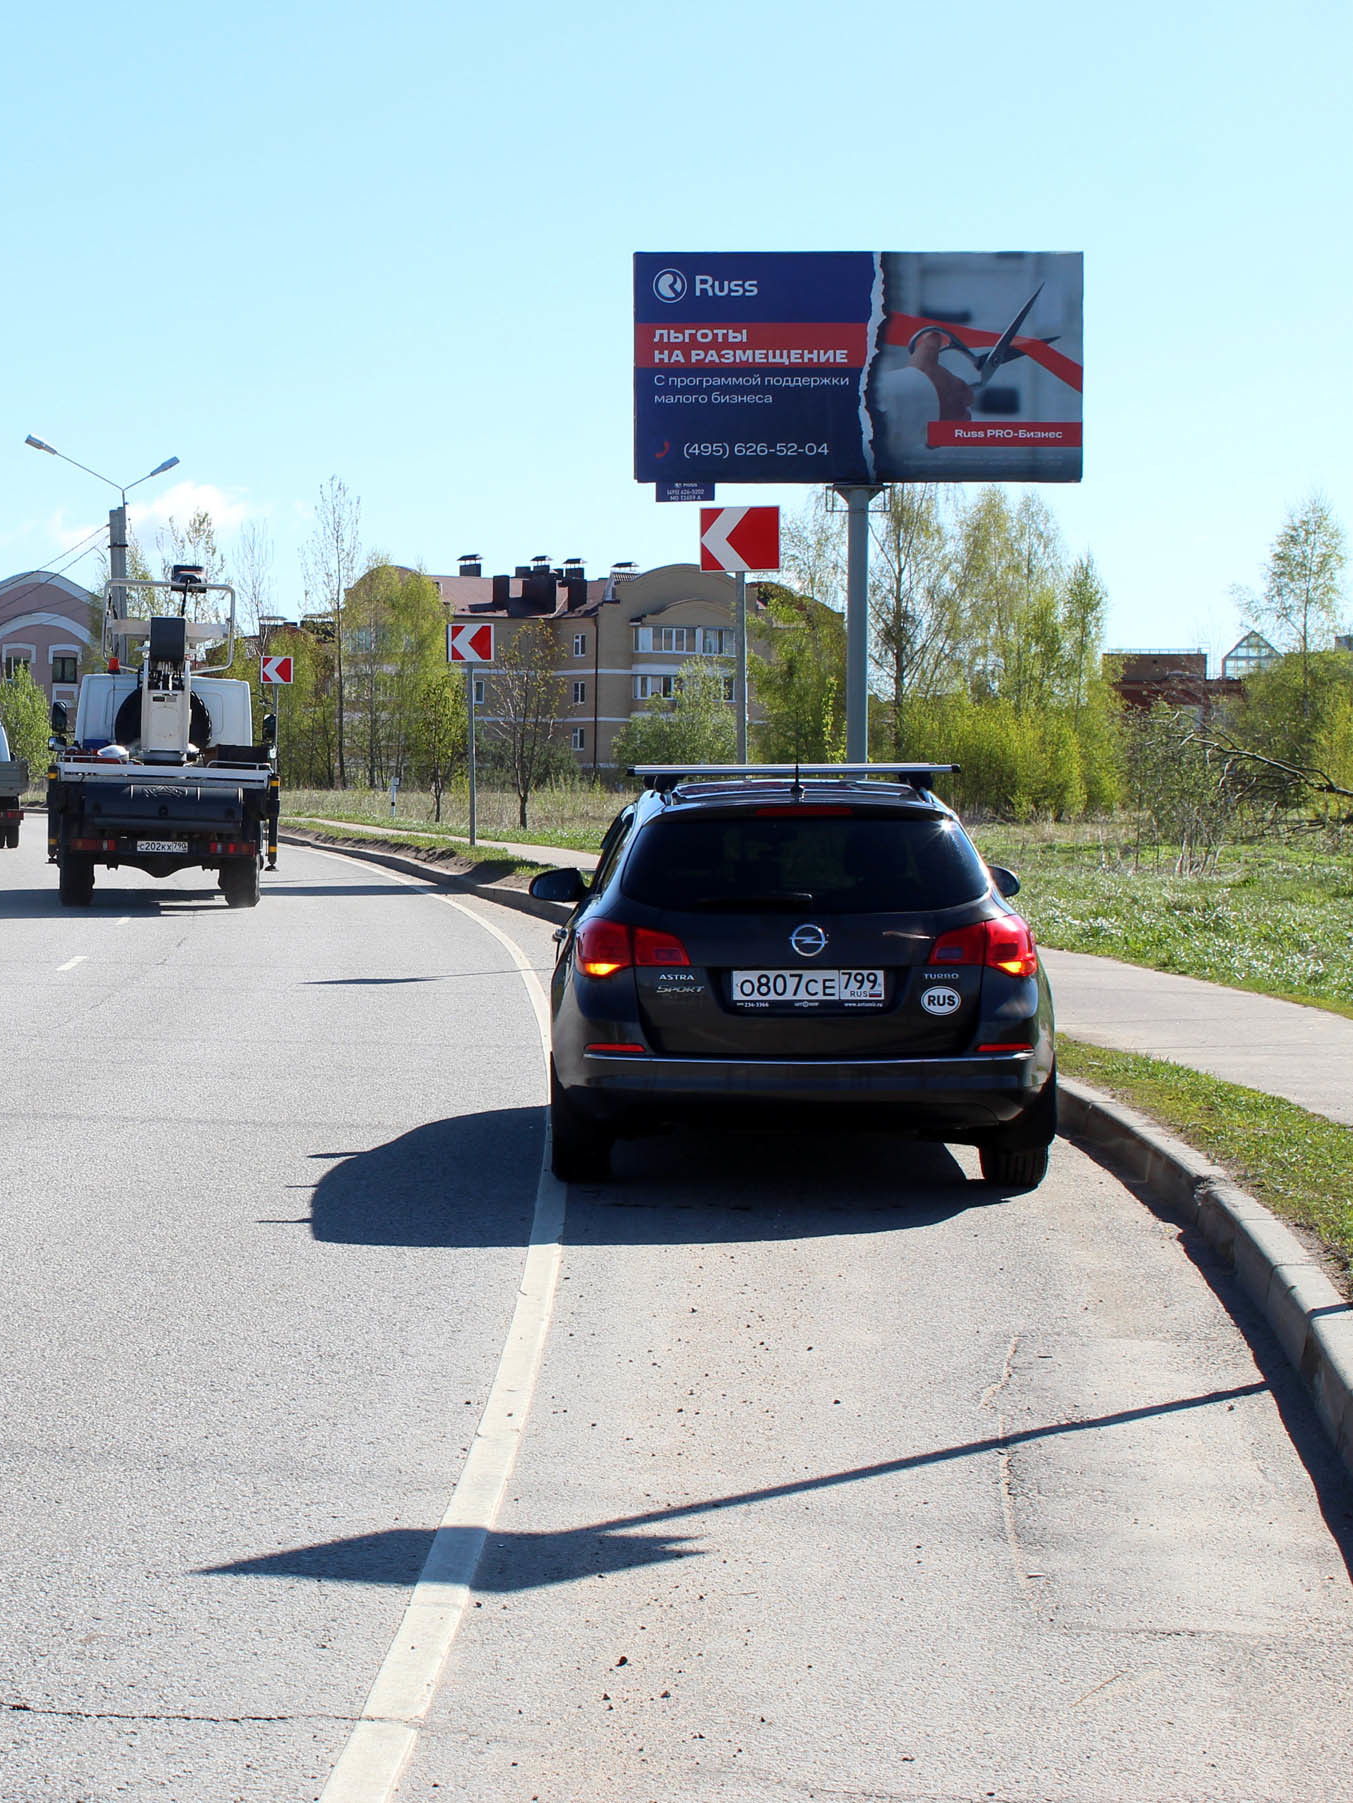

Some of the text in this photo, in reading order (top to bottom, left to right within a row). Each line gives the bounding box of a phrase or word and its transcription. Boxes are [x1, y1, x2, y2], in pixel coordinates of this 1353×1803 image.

[694, 275, 759, 297] Russ
[653, 329, 748, 343] ЛЬГОТЫ
[654, 350, 849, 366] НА РАЗМЕЩЕНИЕ
[654, 374, 849, 389] С программой поддержки
[654, 391, 774, 404] малого бизнеса
[954, 429, 1064, 439] Russ PRO-Бизнес
[683, 442, 830, 459] (495) 626-52-04
[659, 973, 696, 981] ASTRA
[841, 972, 878, 990] 799
[849, 990, 868, 998] RUS
[928, 994, 956, 1007] RUS
